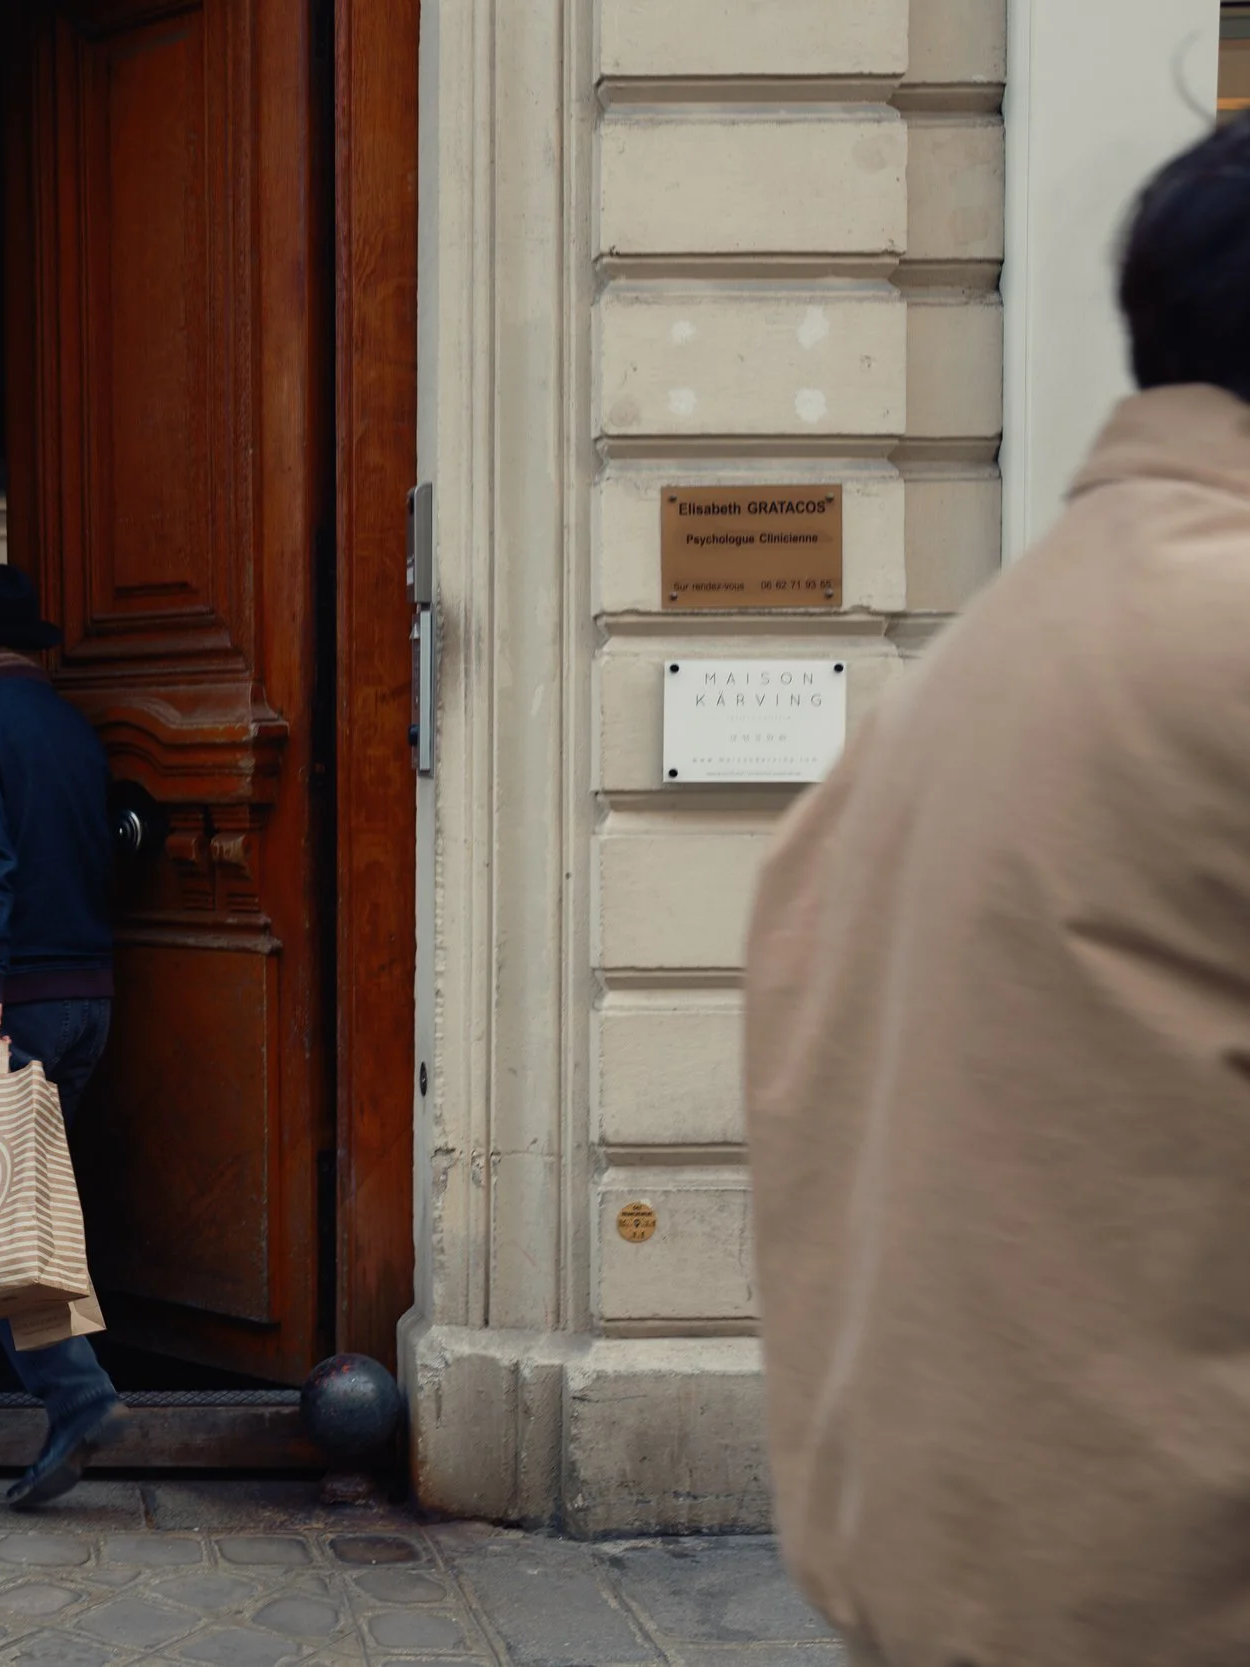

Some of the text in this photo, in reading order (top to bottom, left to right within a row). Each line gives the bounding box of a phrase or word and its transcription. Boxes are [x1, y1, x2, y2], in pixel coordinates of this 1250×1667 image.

[679, 500, 826, 516] Elisabeth GRATACOS
[686, 533, 818, 547] Psychologue Clinicienne
[673, 581, 688, 592] Sur
[791, 580, 801, 590] 71
[704, 672, 813, 685] MAISON
